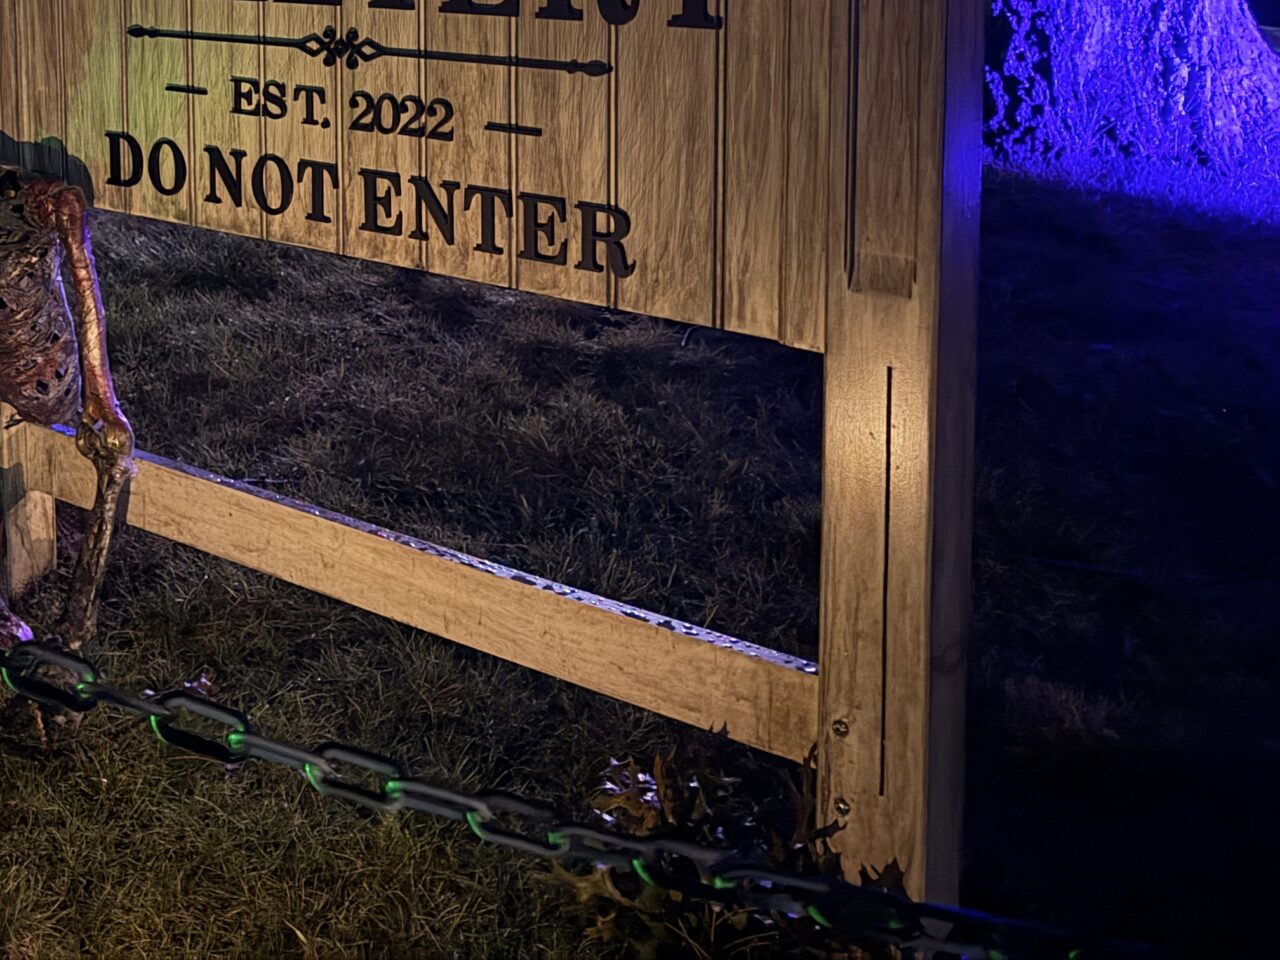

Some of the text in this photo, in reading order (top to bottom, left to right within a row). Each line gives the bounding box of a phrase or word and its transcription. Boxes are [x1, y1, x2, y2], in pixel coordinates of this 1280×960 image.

[230, 76, 455, 142] EST. 2022
[104, 130, 637, 278] DO NOT ENTER
